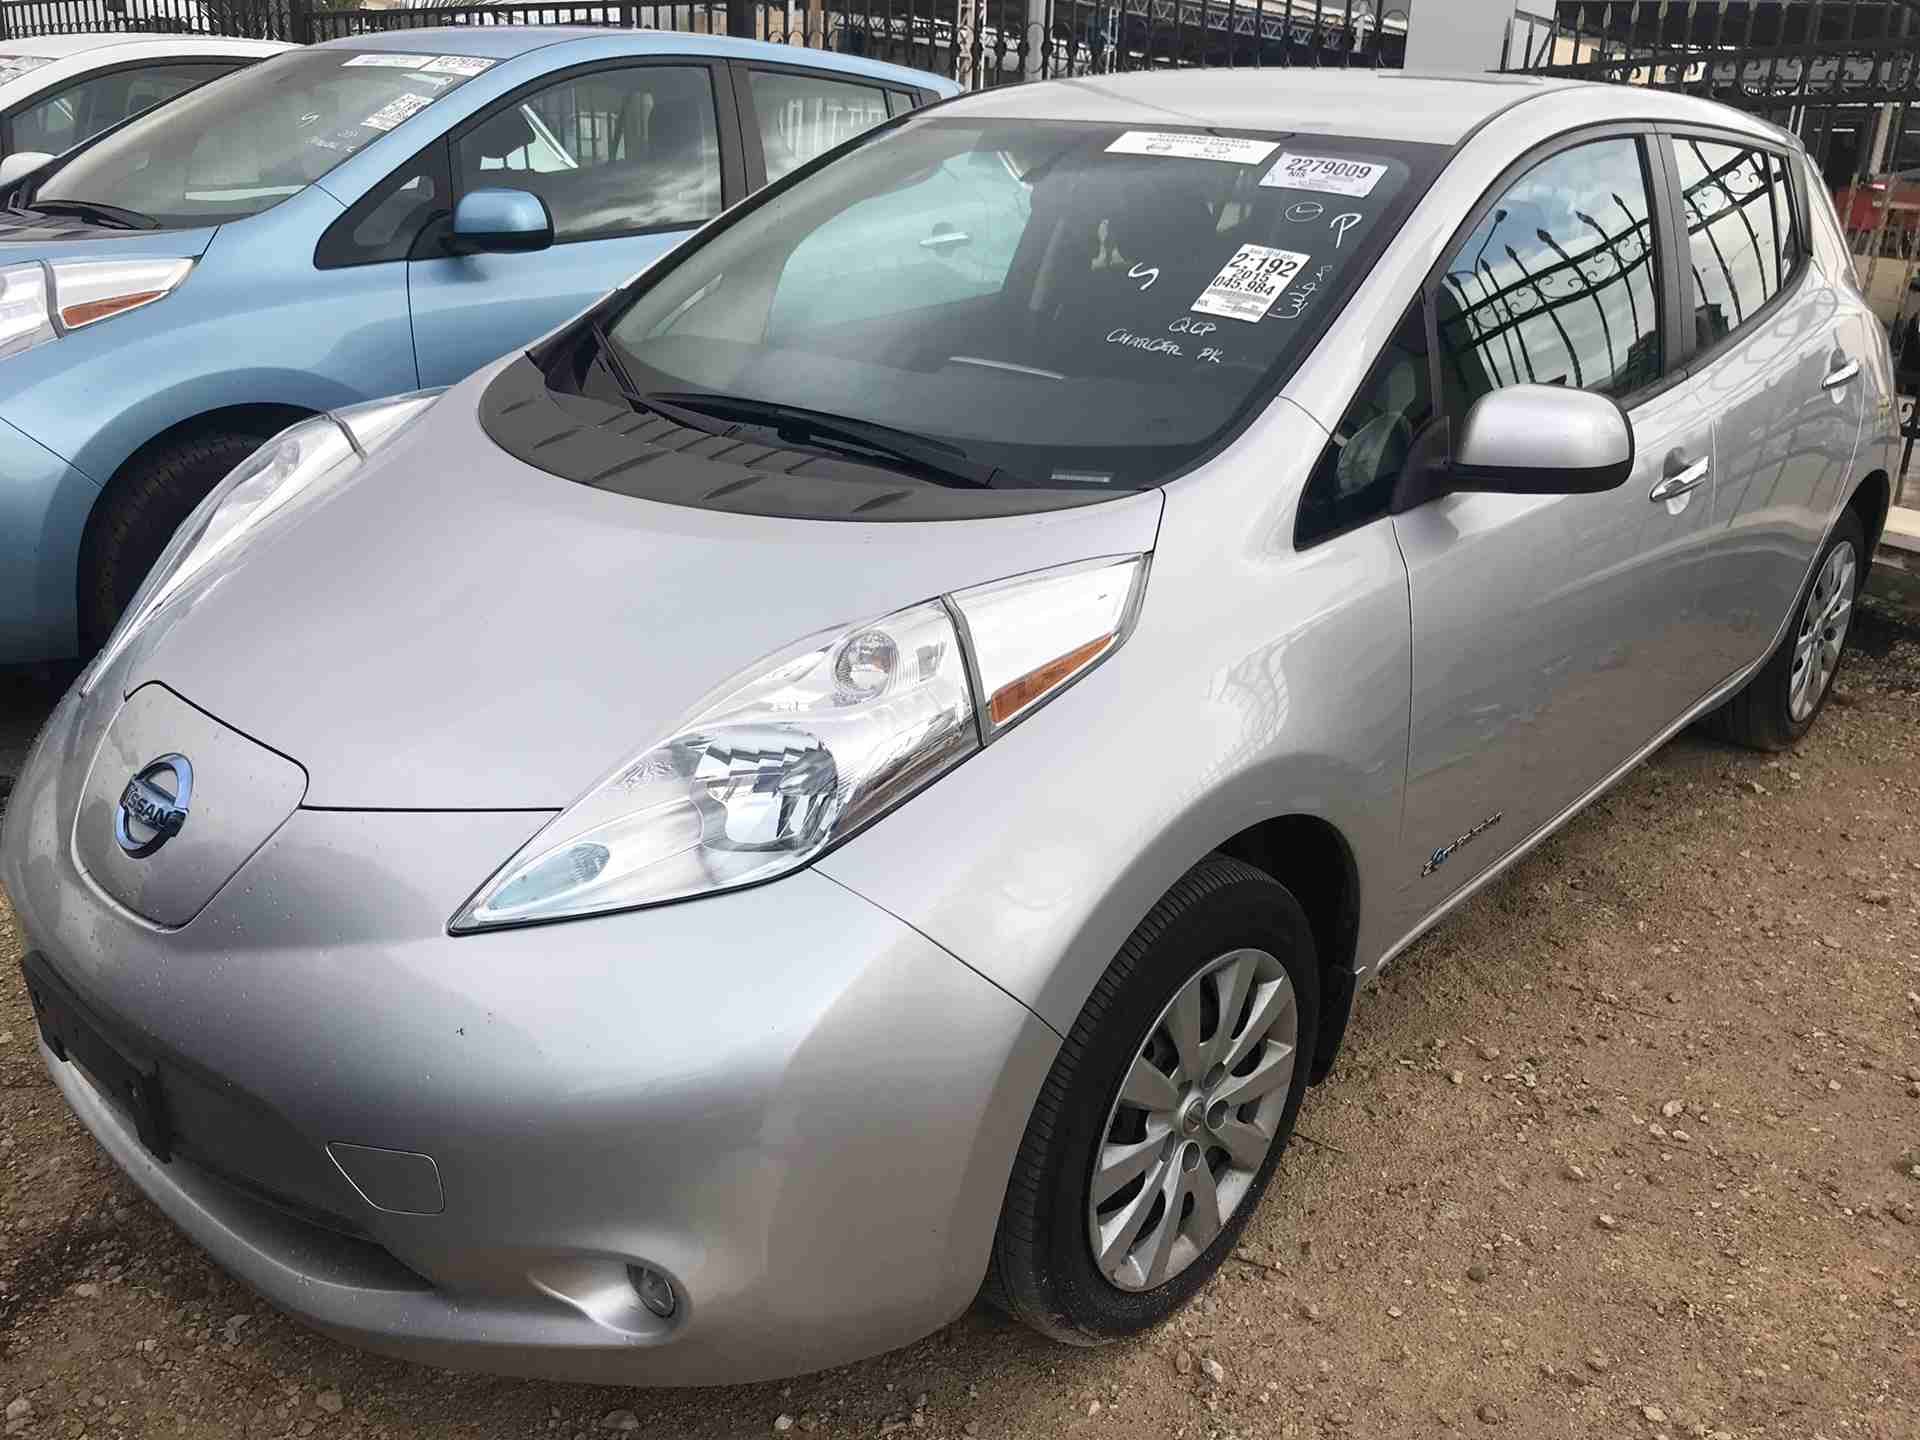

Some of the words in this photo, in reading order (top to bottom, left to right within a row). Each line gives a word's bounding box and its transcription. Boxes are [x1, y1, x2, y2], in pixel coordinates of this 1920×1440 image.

[1285, 158, 1372, 179] 2279009
[1329, 212, 1363, 249] P
[1127, 261, 1160, 291] S
[1229, 252, 1298, 278] 2:192
[1232, 268, 1270, 284] 2015
[126, 781, 174, 828] NISSAN
